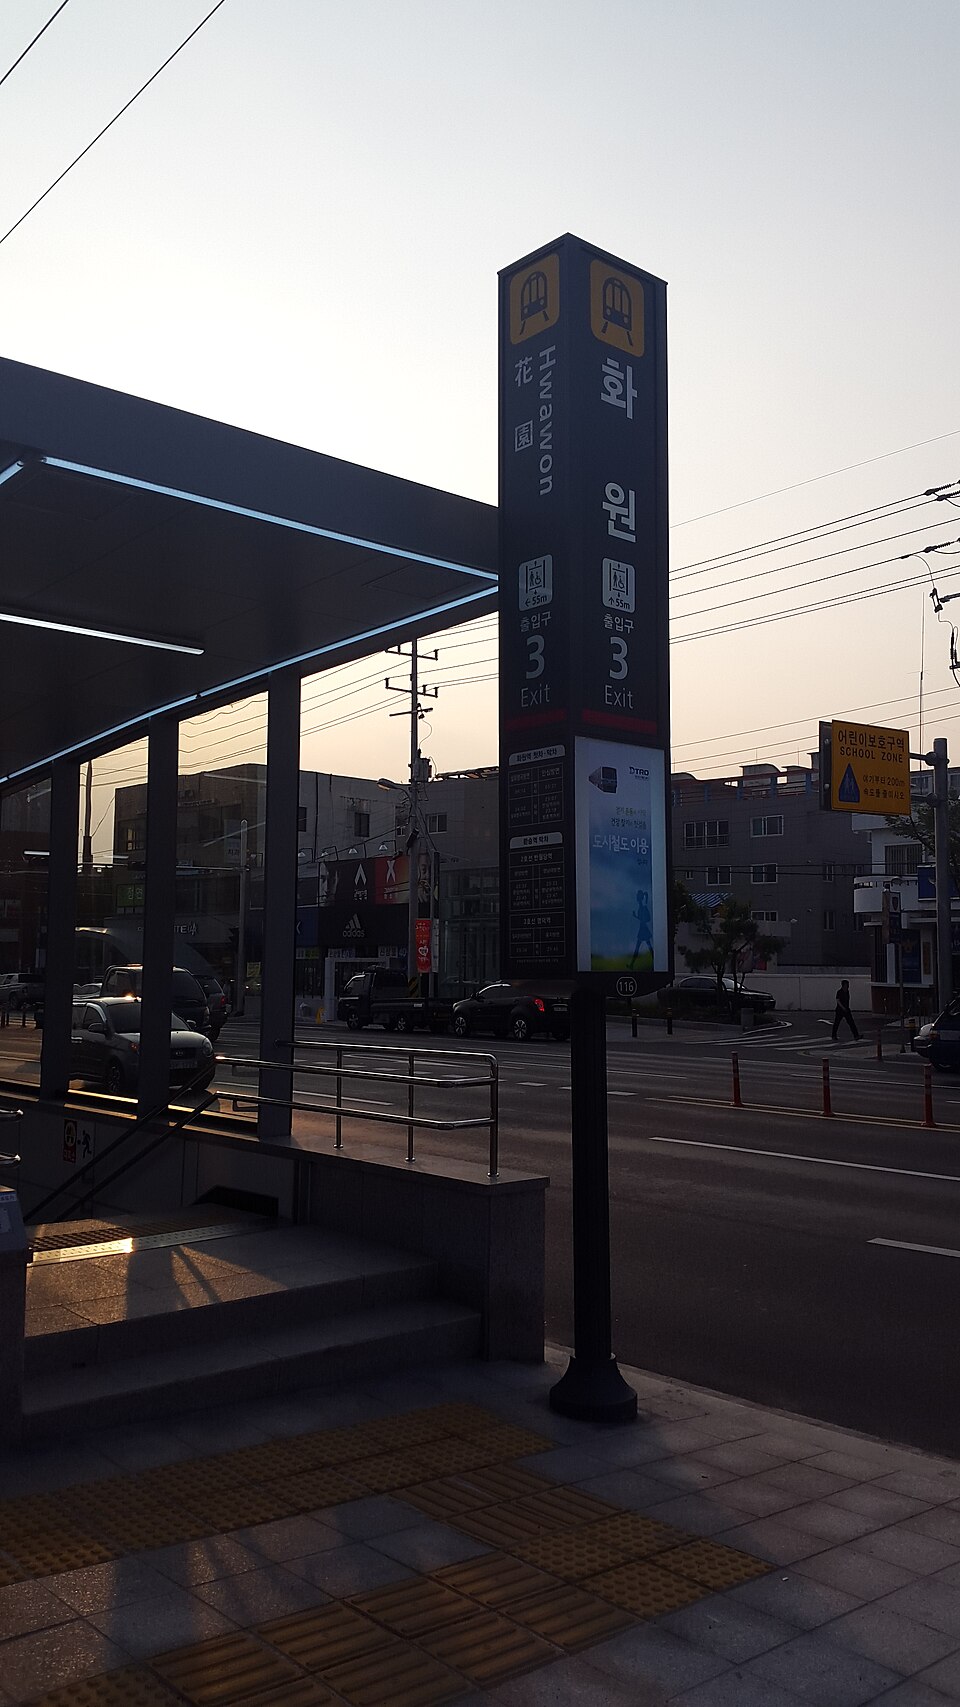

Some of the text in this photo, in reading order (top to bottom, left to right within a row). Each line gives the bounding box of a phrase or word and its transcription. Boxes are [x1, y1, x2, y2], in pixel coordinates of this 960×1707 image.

[539, 344, 556, 496] Hwawon
[531, 593, 549, 606] 55m
[615, 598, 632, 611] 55m
[519, 610, 553, 633] 출입구
[603, 612, 635, 635] 출입구
[525, 635, 546, 680] 3
[608, 635, 630, 680] 3
[520, 684, 551, 709] Exit
[604, 684, 634, 710] Exit
[839, 730, 905, 750] 어린이보호구역
[839, 746, 904, 763] SCHOOL ZONE
[592, 834, 650, 855] 도시철도 이용
[342, 929, 366, 939] adidas
[619, 980, 635, 993] 116
